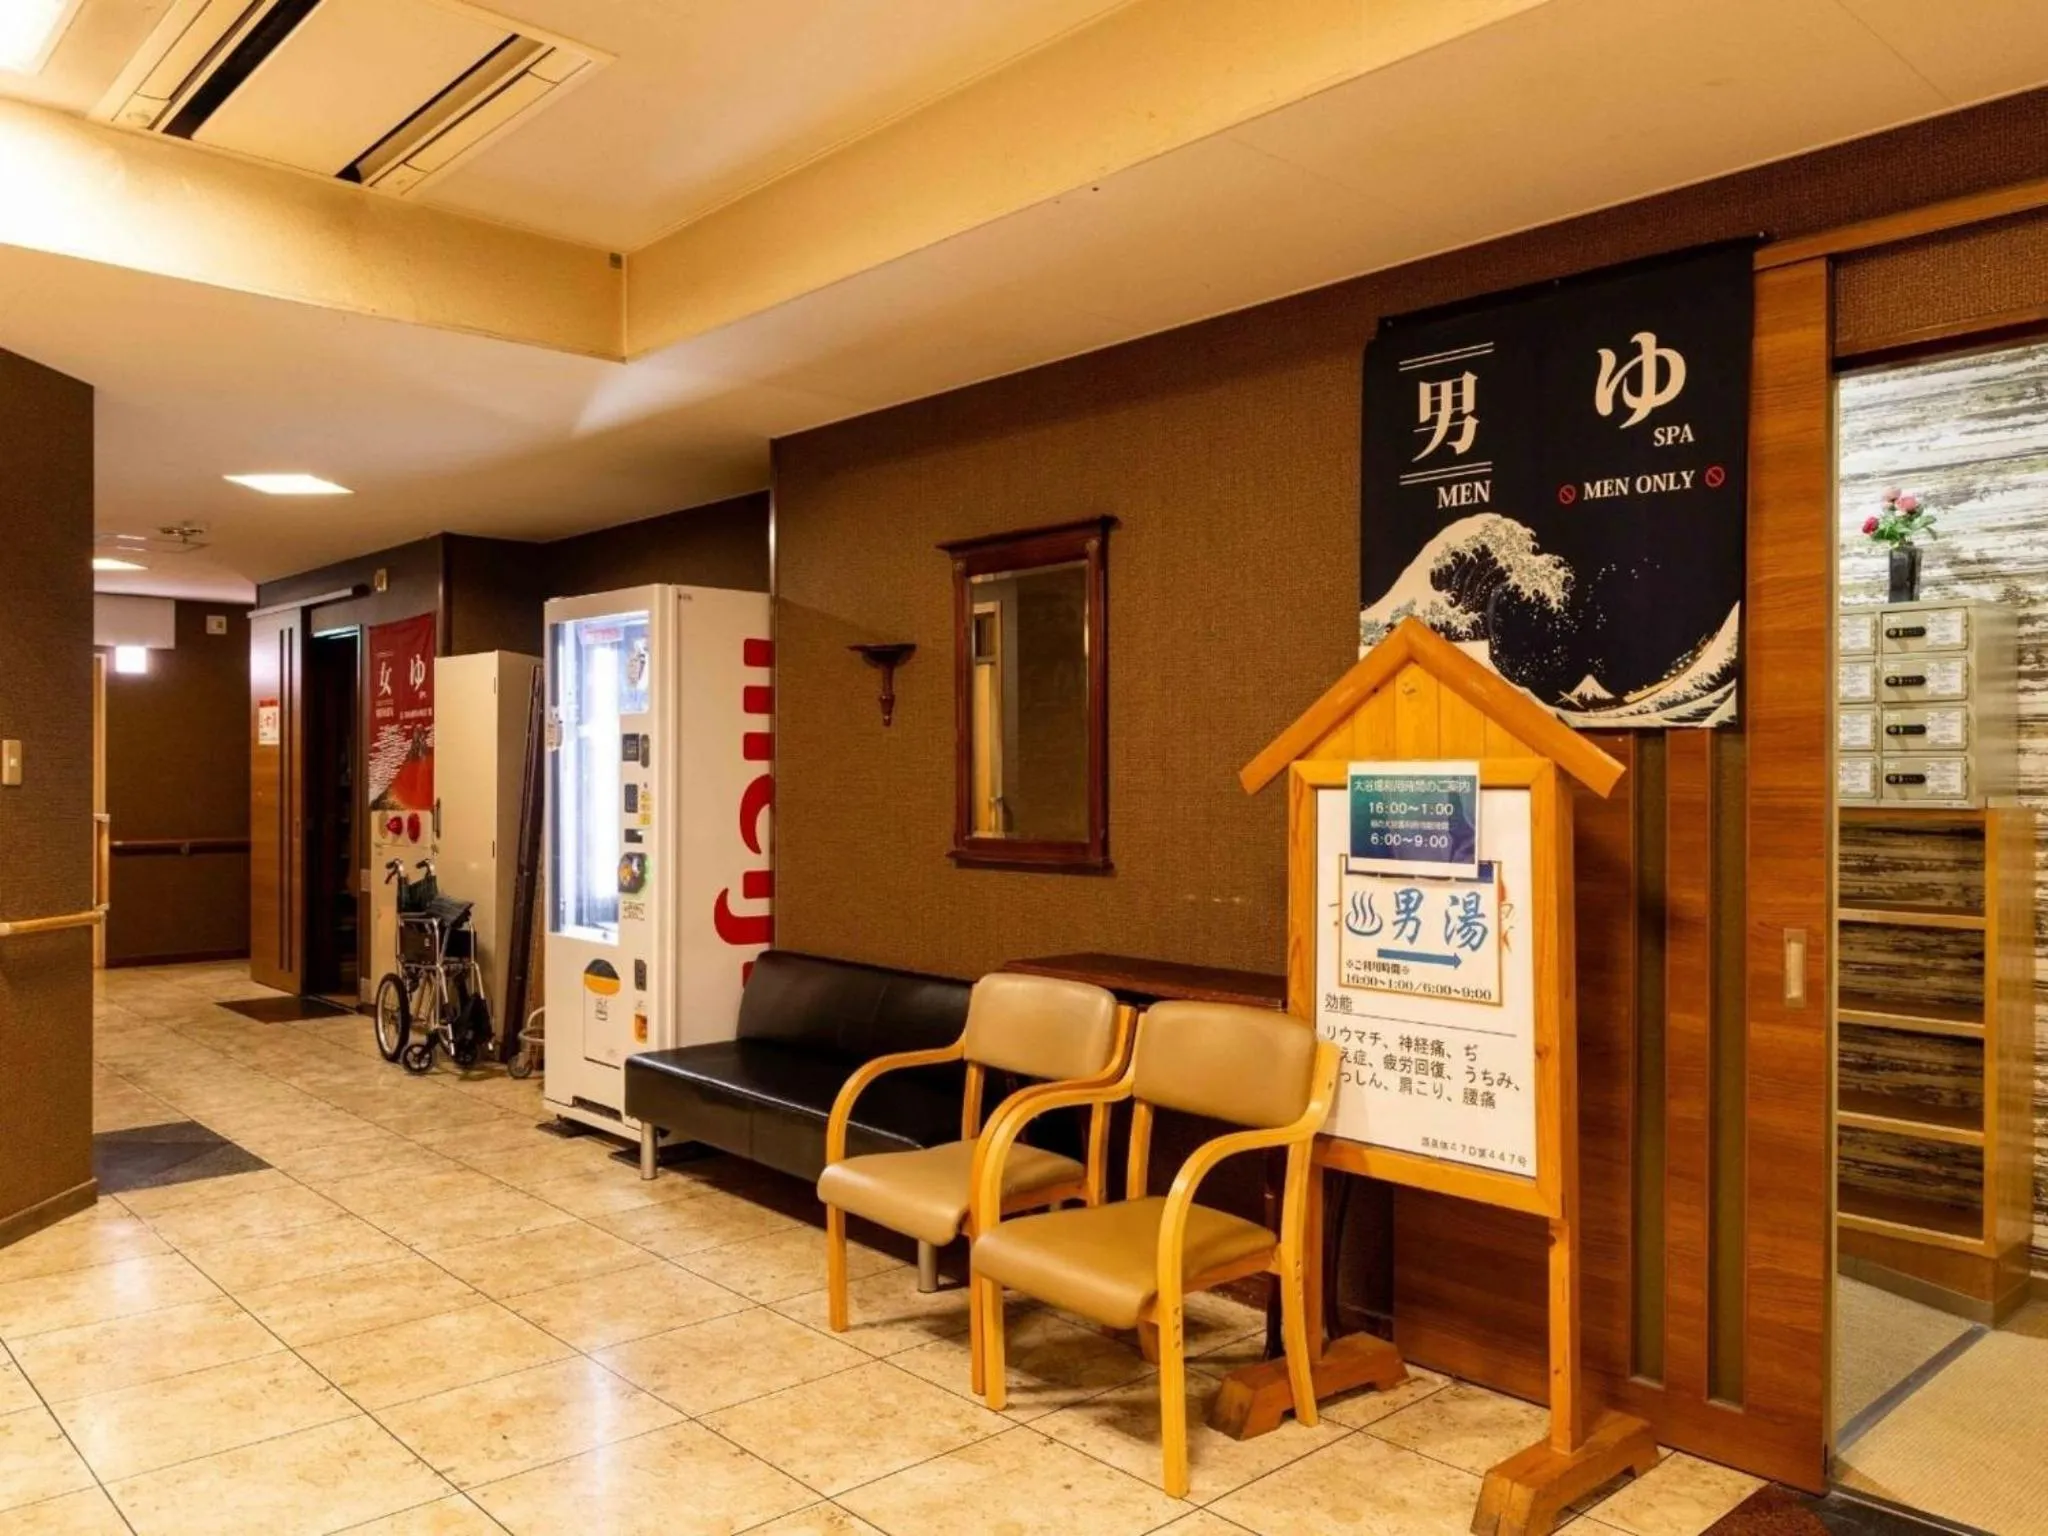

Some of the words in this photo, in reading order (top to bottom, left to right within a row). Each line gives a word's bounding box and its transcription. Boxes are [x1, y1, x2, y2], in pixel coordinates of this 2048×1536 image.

[1594, 331, 1687, 430] ゆ
[1412, 371, 1480, 463] 男
[1653, 424, 1695, 447] SPA
[1437, 480, 1492, 509] MEN
[1583, 476, 1630, 501] MEN
[1635, 470, 1695, 497] ONLY
[378, 661, 393, 697] 女
[409, 653, 426, 691] ゆ
[1392, 888, 1489, 951] 男湯
[1325, 993, 1353, 1012] 効能
[1339, 1071, 1497, 1109] っしん、肩こり、腰痛
